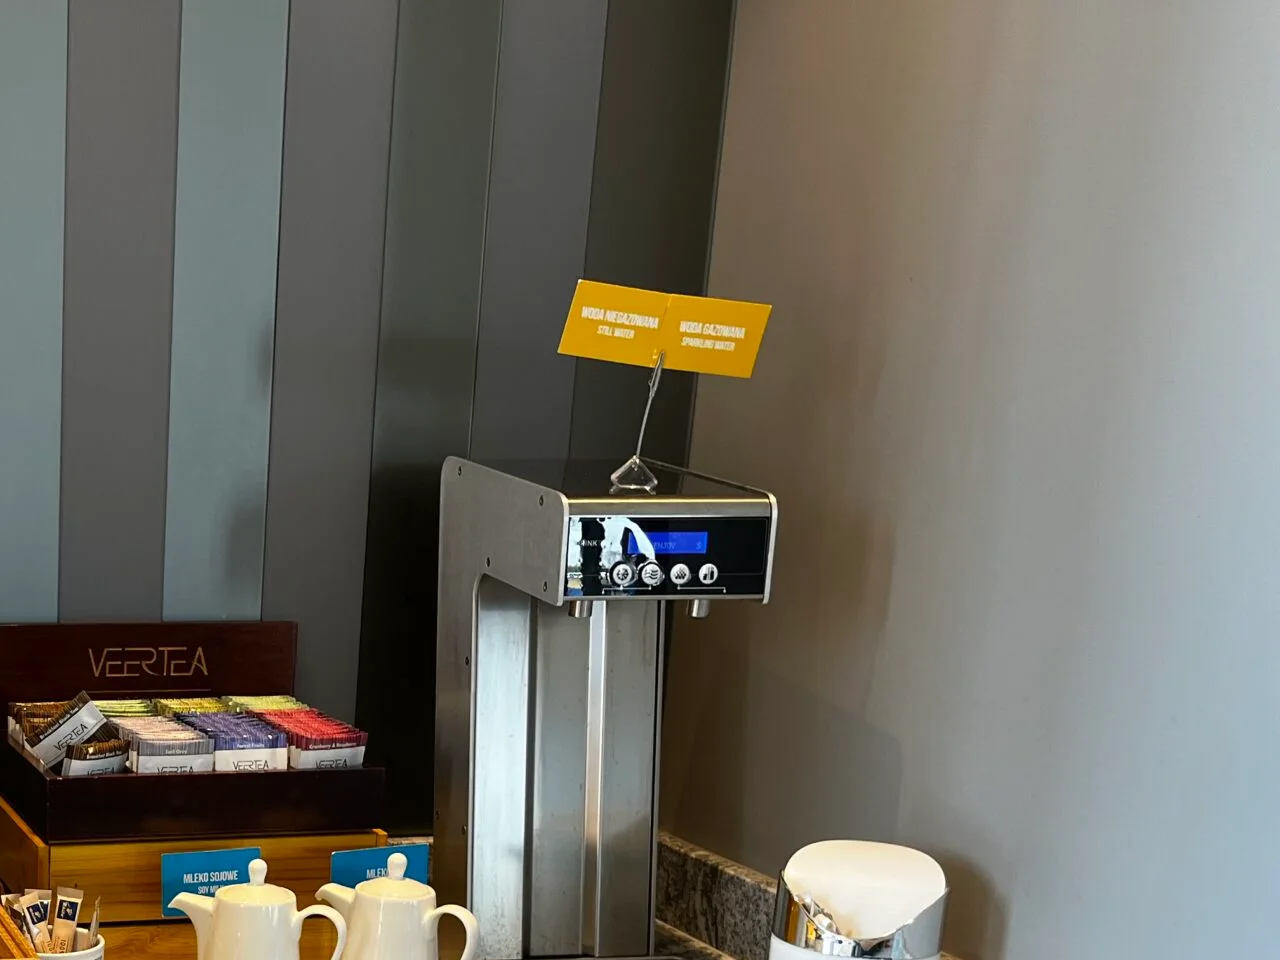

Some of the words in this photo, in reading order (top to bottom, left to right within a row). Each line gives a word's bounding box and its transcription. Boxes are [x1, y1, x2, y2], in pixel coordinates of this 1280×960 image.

[88, 646, 209, 677] VEERTEA
[183, 872, 208, 884] MLEKO
[209, 869, 239, 883] SOJOWE
[366, 867, 389, 879] MLEK
[197, 885, 210, 895] SOY
